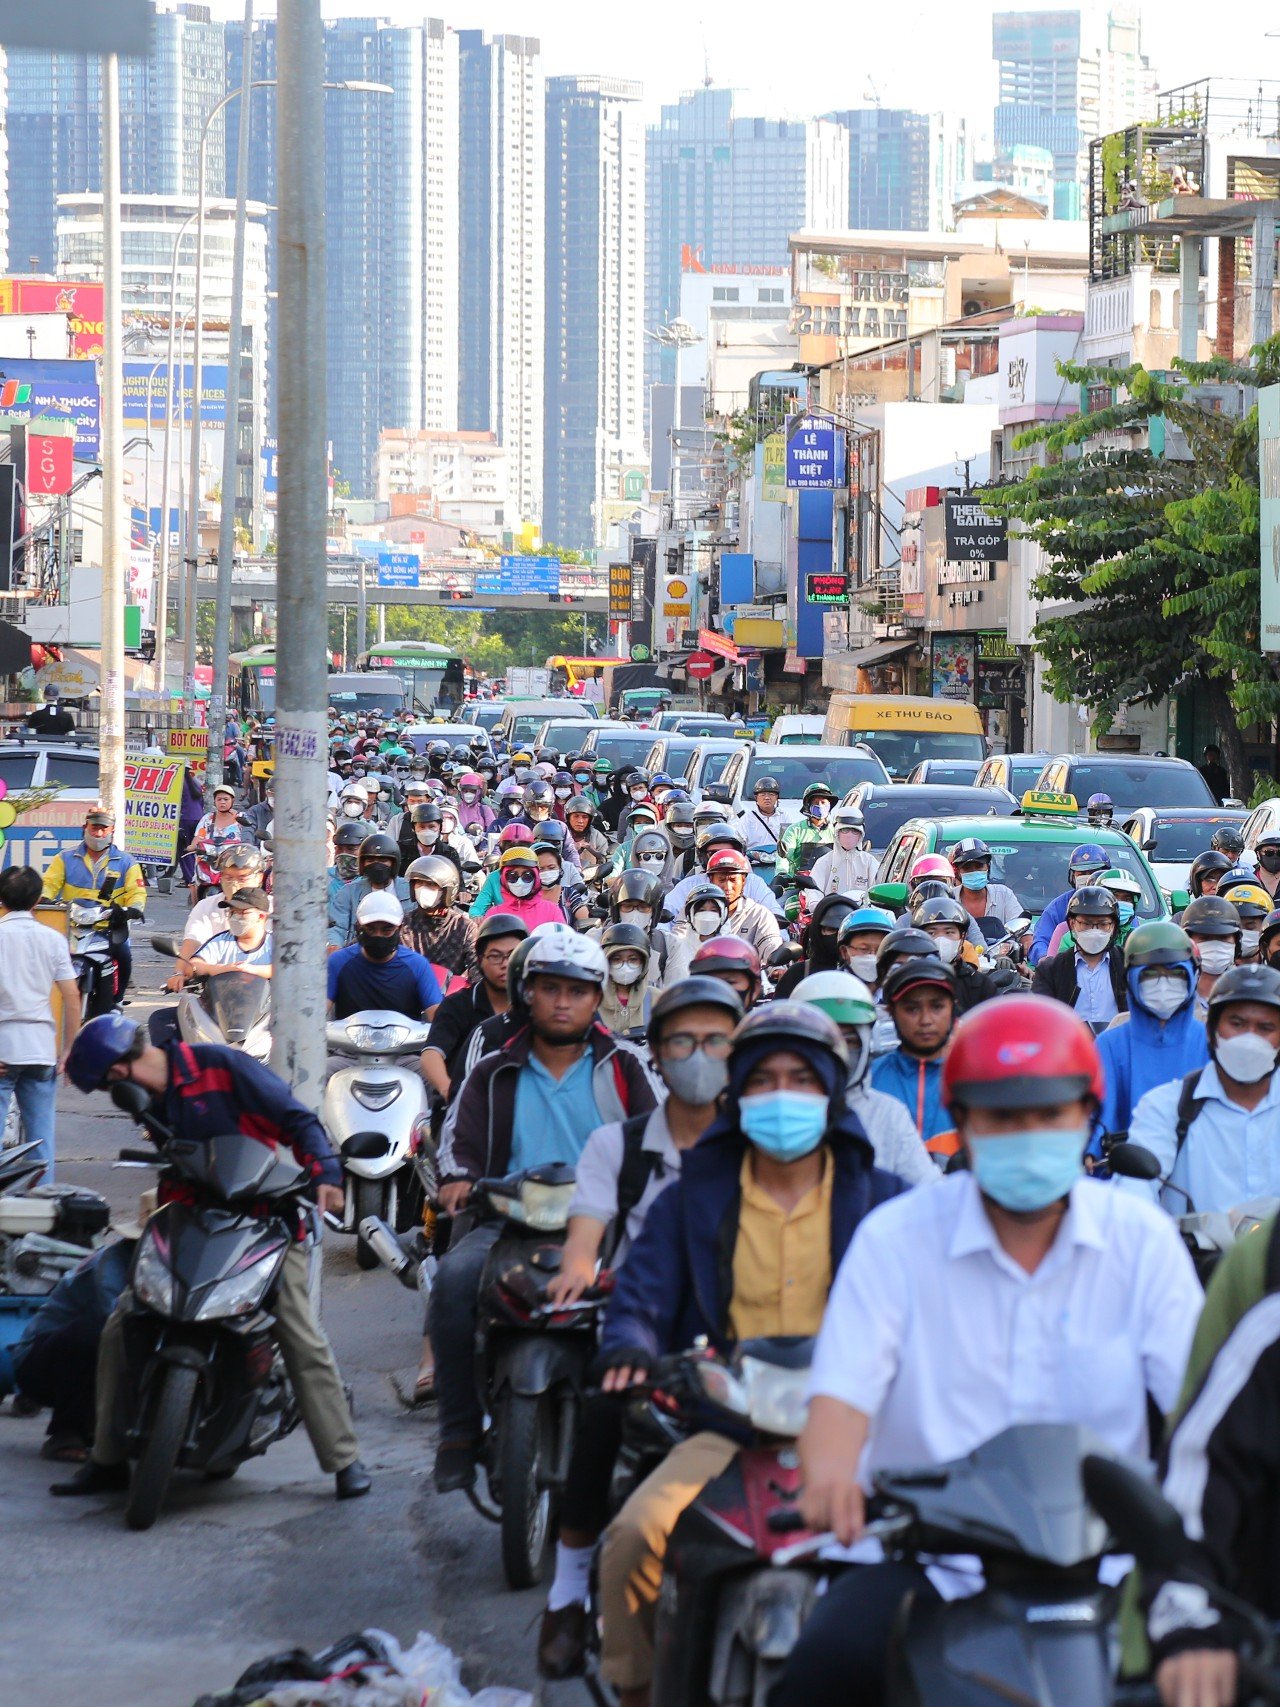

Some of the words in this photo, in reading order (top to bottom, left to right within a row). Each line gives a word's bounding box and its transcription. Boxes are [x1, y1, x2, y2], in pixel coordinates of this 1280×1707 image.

[60, 395, 97, 407] THUỐC
[804, 432, 817, 445] LÊ
[793, 448, 829, 460] THÀNH
[800, 463, 823, 477] KIỆT
[956, 516, 1003, 527] GAMES
[978, 534, 1000, 546] GÓP
[970, 549, 985, 559] 0%
[1000, 679, 1021, 689] 375
[876, 710, 893, 719] XE
[895, 710, 922, 719] THƯ
[924, 709, 953, 721] BÁO
[135, 801, 160, 818] KEO
[162, 803, 177, 819] XE
